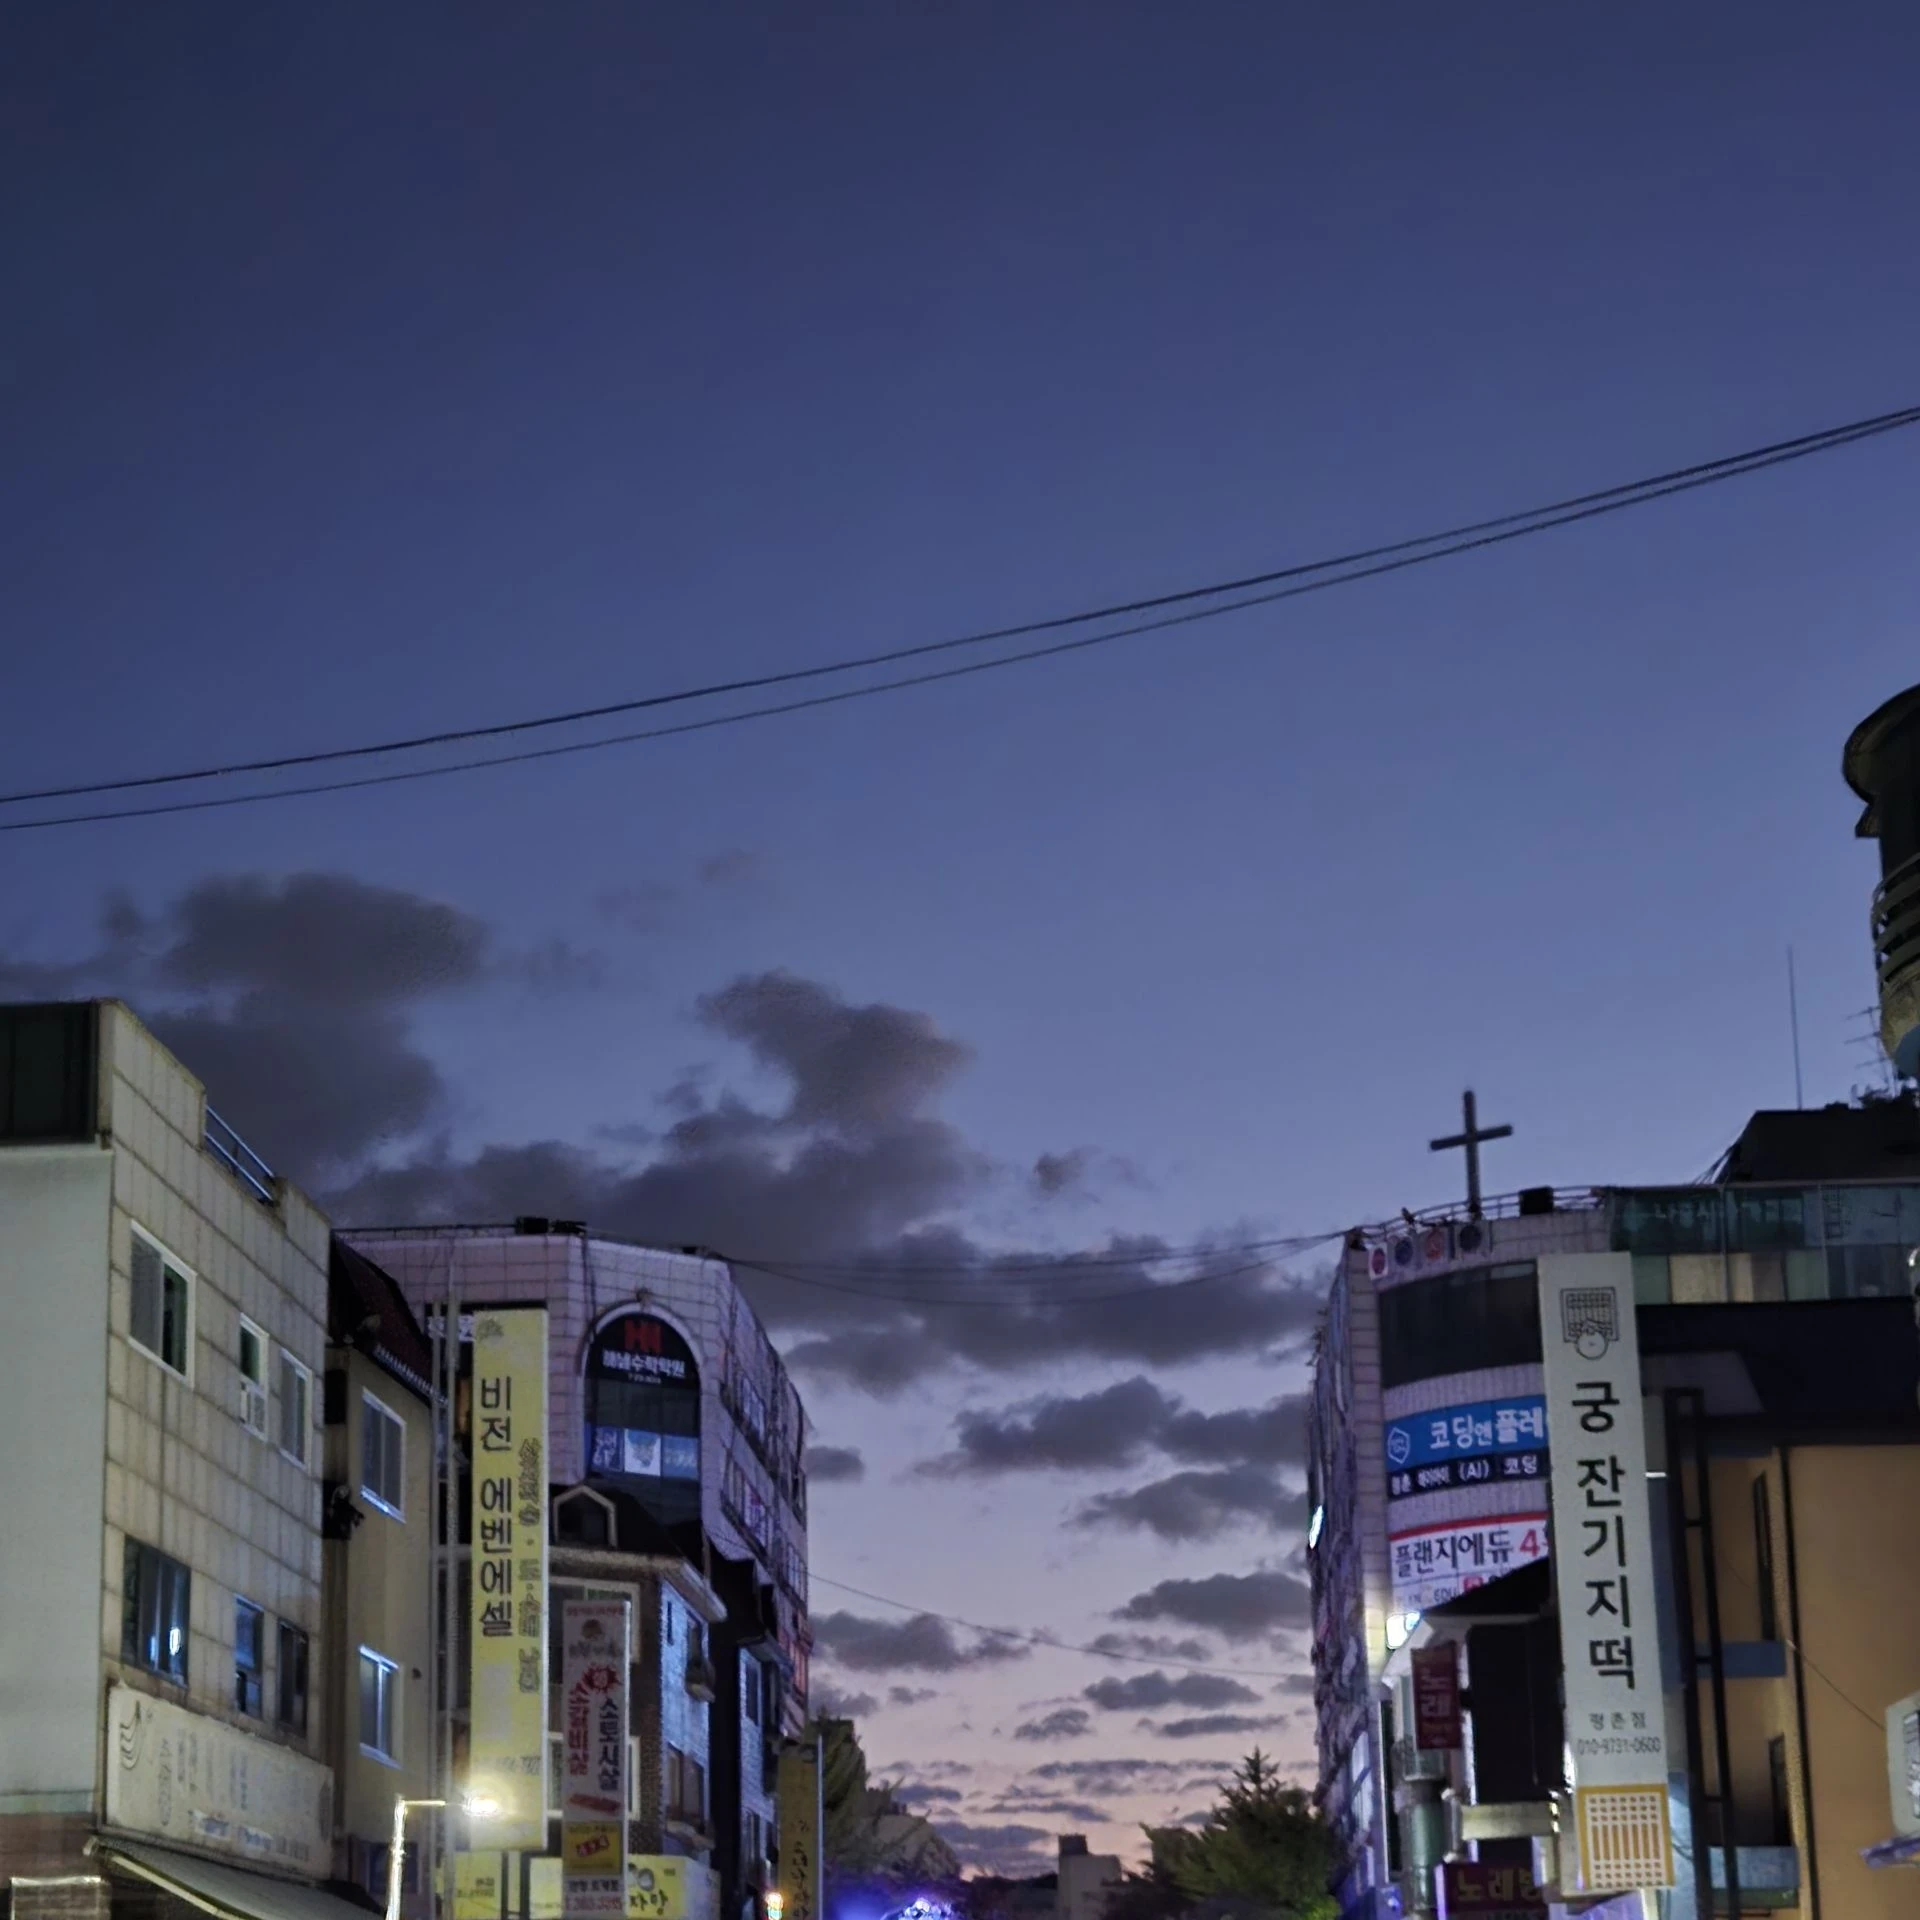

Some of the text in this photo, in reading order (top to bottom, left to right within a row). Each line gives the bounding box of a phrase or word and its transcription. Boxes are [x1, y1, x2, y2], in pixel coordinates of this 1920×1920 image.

[1430, 1406, 1545, 1449] 코딩엔플레
[479, 1375, 513, 1637] 비전 에벤에셀
[1394, 1527, 1549, 1578] 플랜지에듀 4
[1571, 1381, 1635, 1689] 궁 잔기지떡
